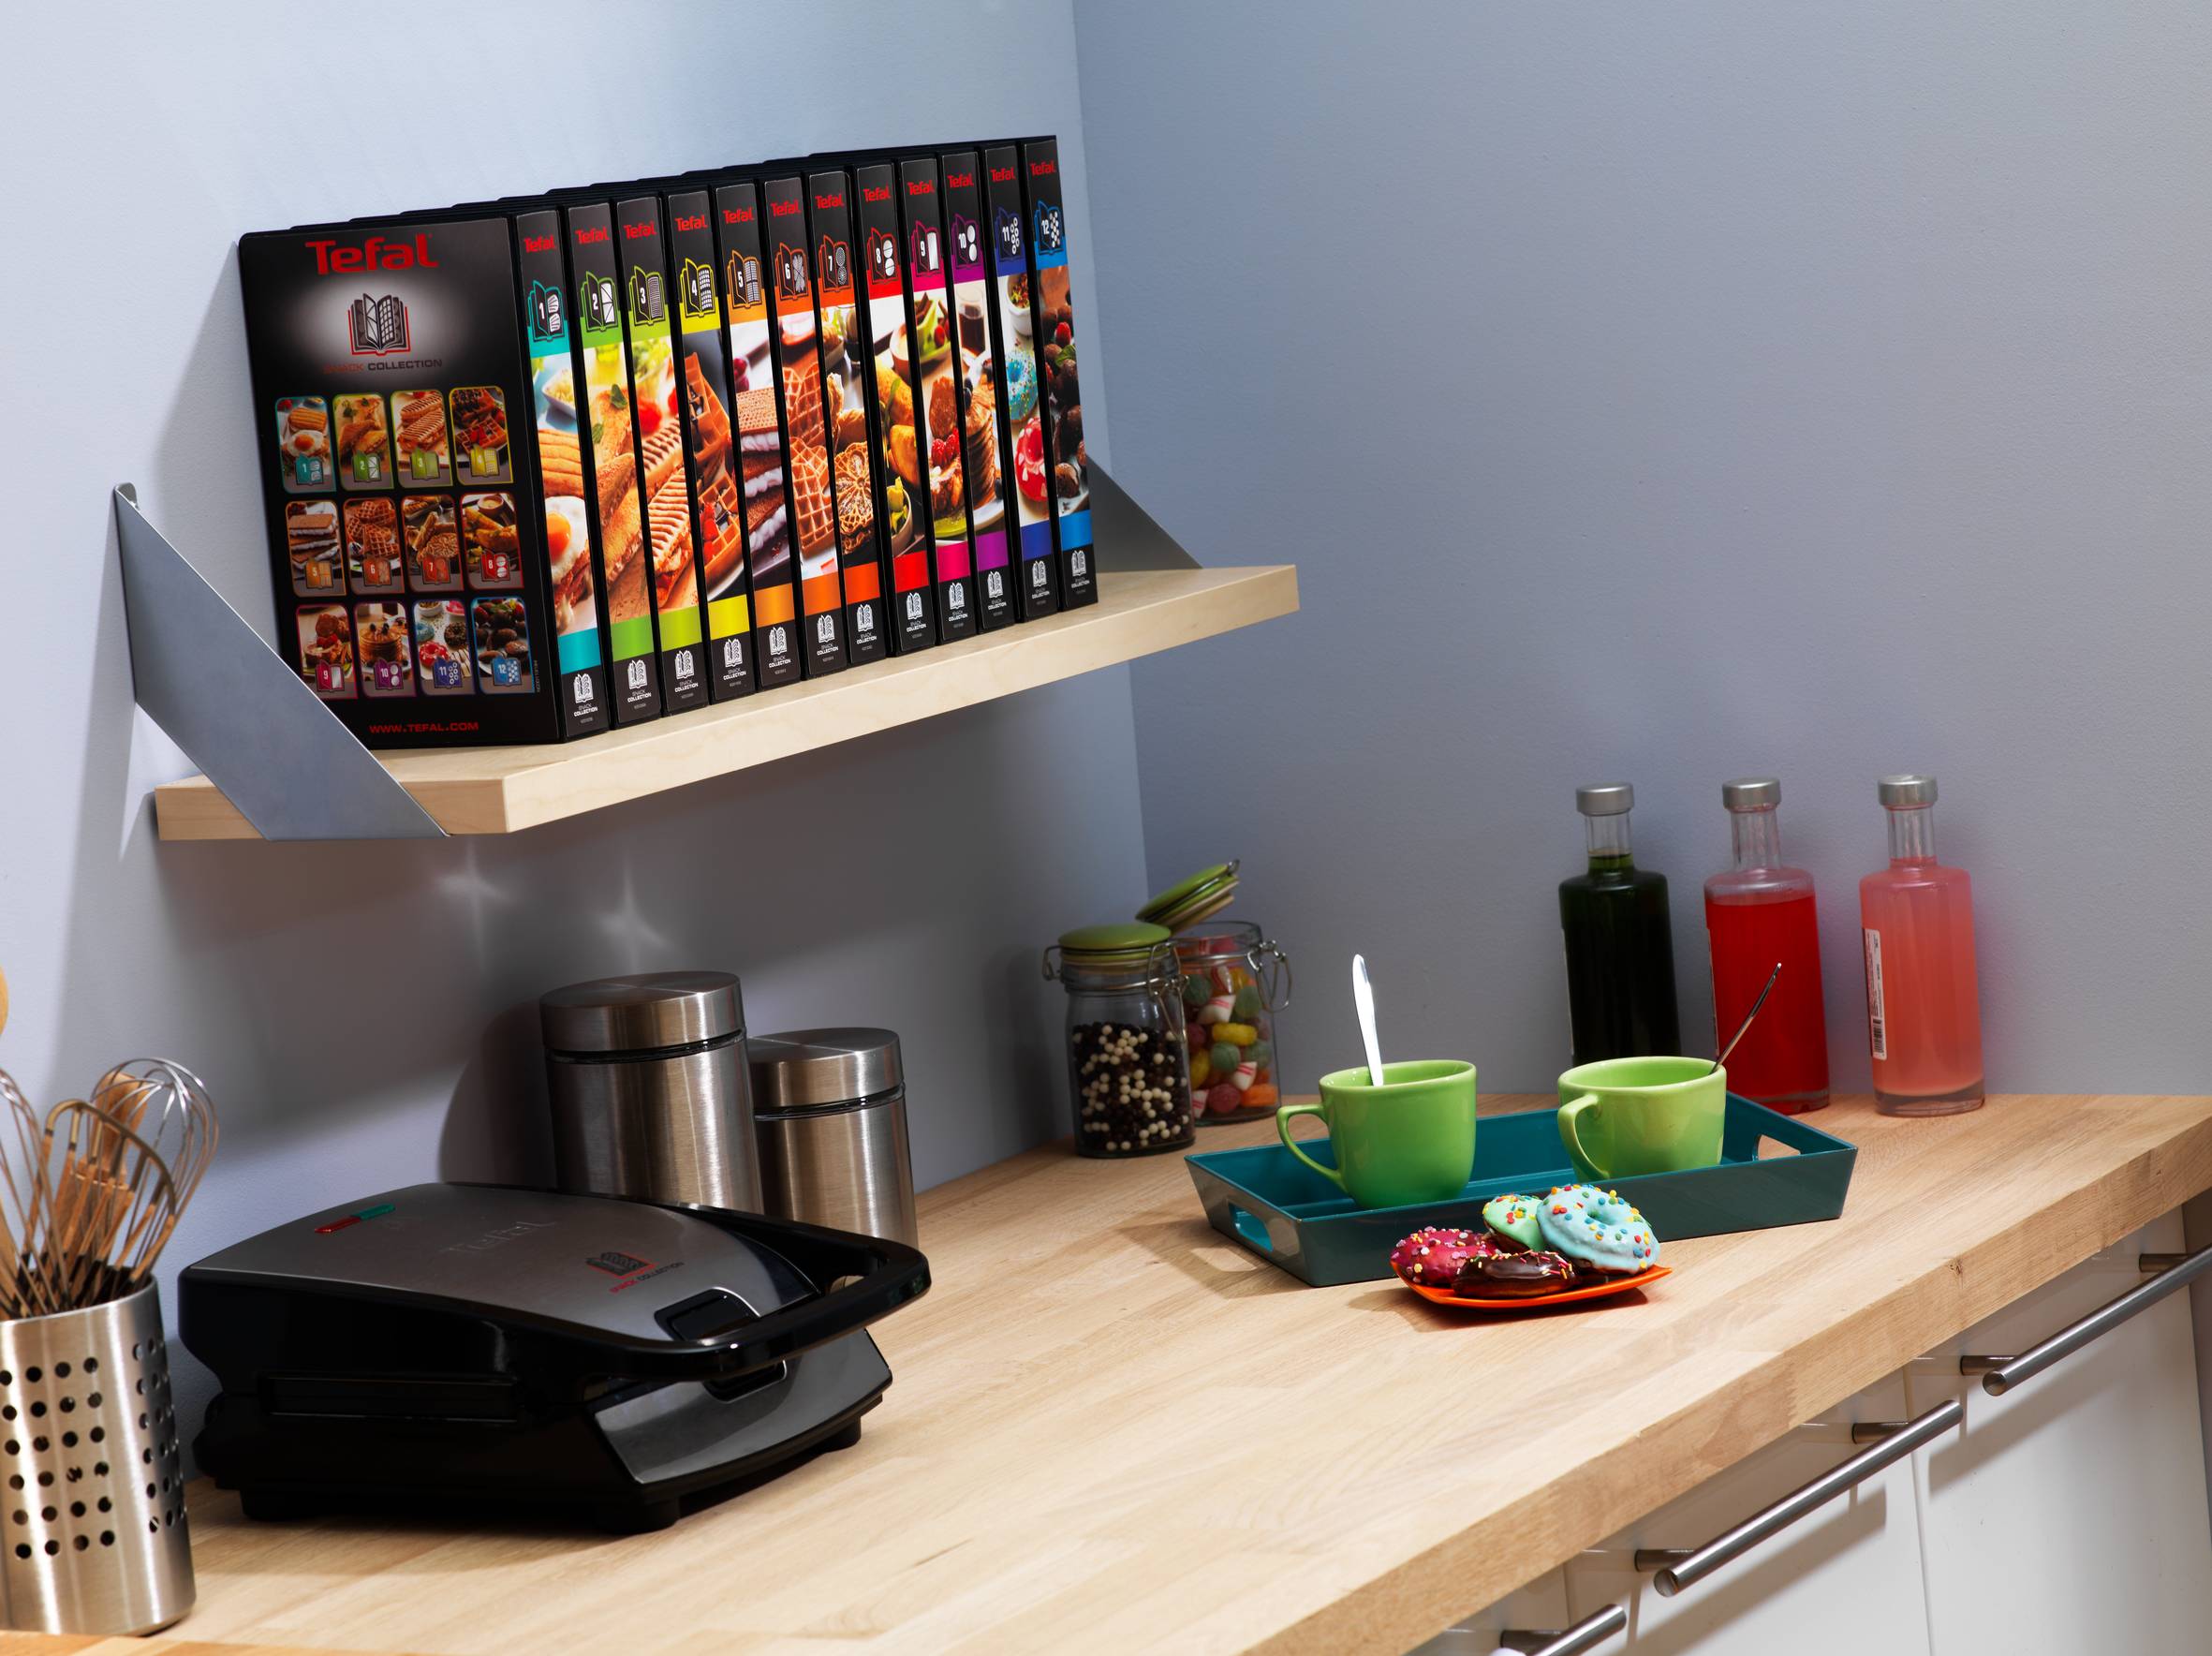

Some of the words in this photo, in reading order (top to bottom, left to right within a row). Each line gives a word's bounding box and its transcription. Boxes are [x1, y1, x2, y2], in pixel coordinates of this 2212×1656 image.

[991, 168, 1014, 181] Tefal
[1031, 162, 1054, 175] Tefal
[908, 180, 933, 195] Tefal
[948, 174, 973, 187] Tefal
[863, 186, 890, 201] Tefal
[772, 200, 799, 215] Tefal
[816, 195, 843, 208] Tefal
[675, 215, 707, 230] Tefal
[724, 208, 753, 223] Tefal
[625, 223, 656, 239] Tefal
[1040, 219, 1049, 234] 12
[576, 228, 609, 244] Tefal
[958, 232, 966, 249] 10
[1002, 227, 1010, 242] 11
[524, 236, 554, 252] Tefal
[920, 241, 925, 257] 9
[305, 233, 439, 275] Tefal
[876, 248, 881, 263] 8
[785, 263, 790, 278] 6
[829, 256, 833, 271] 7
[737, 272, 743, 288] 5
[640, 288, 646, 303] 3
[691, 280, 697, 296] 4
[592, 293, 598, 310] 2
[539, 303, 545, 319] 1
[367, 359, 443, 371] COLLECTION
[988, 601, 1007, 610] COLLECTION
[949, 614, 967, 622] COLLECTION
[907, 624, 926, 632] COLLECTION
[857, 635, 877, 644] COLLECTION
[817, 646, 838, 656] COLLECTION
[769, 659, 790, 668] COLLECTION
[723, 671, 746, 680] COLLECTION
[674, 683, 699, 693] COLLECTION
[627, 692, 652, 702] COLLECTION
[574, 706, 597, 717] COLLECTION
[370, 722, 479, 733] WWW.TEFAL.COM
